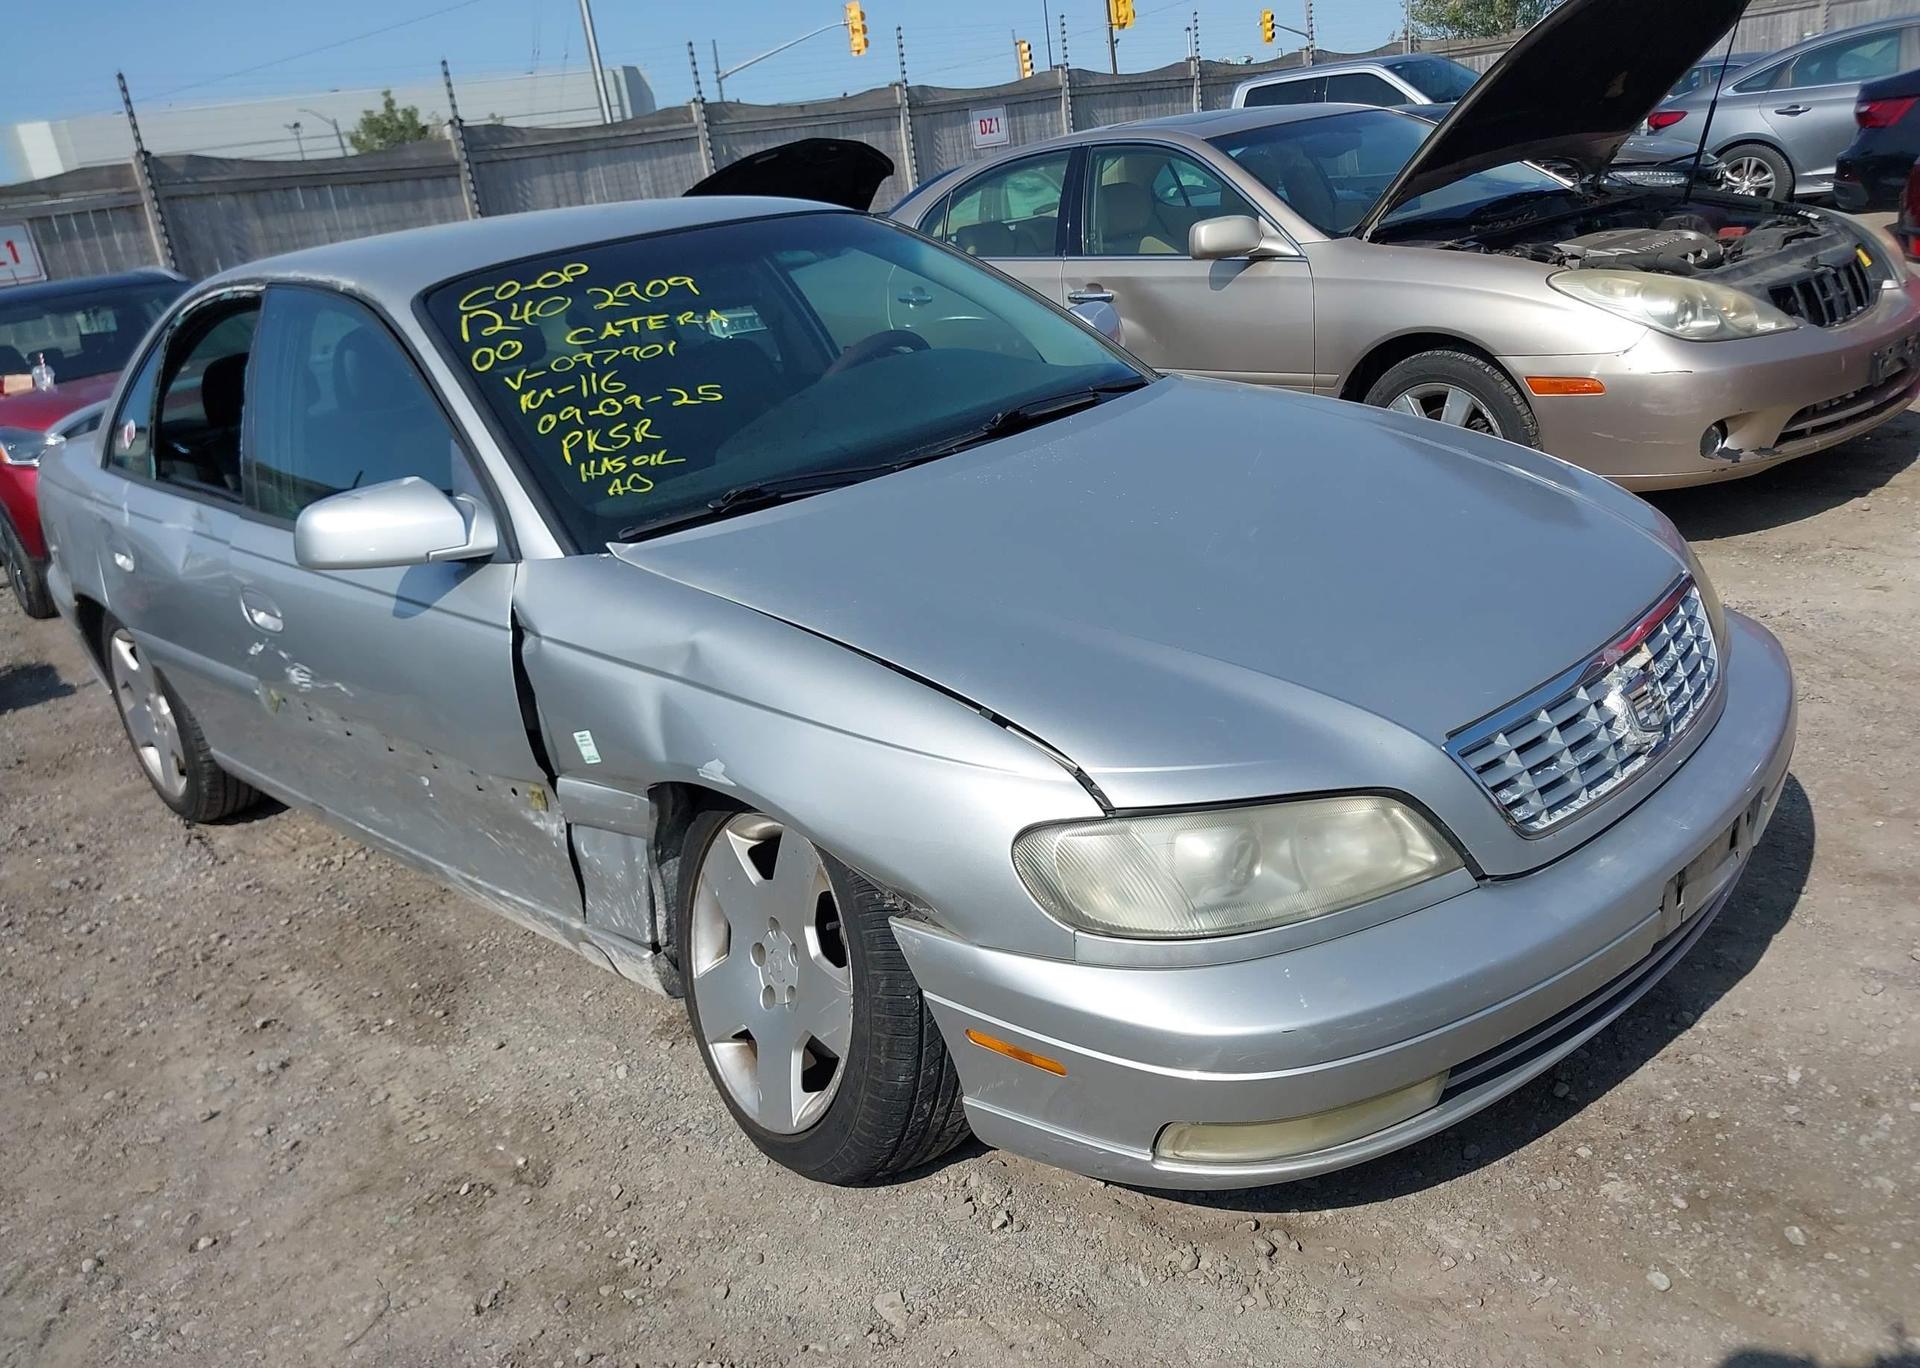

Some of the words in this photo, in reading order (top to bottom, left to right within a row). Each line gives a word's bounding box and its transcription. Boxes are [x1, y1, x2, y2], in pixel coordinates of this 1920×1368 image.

[979, 117, 1000, 135] DZ1
[586, 275, 701, 310] 2909
[471, 339, 523, 372] 00
[565, 309, 729, 345] CATERA
[537, 384, 724, 435] 09-09-25
